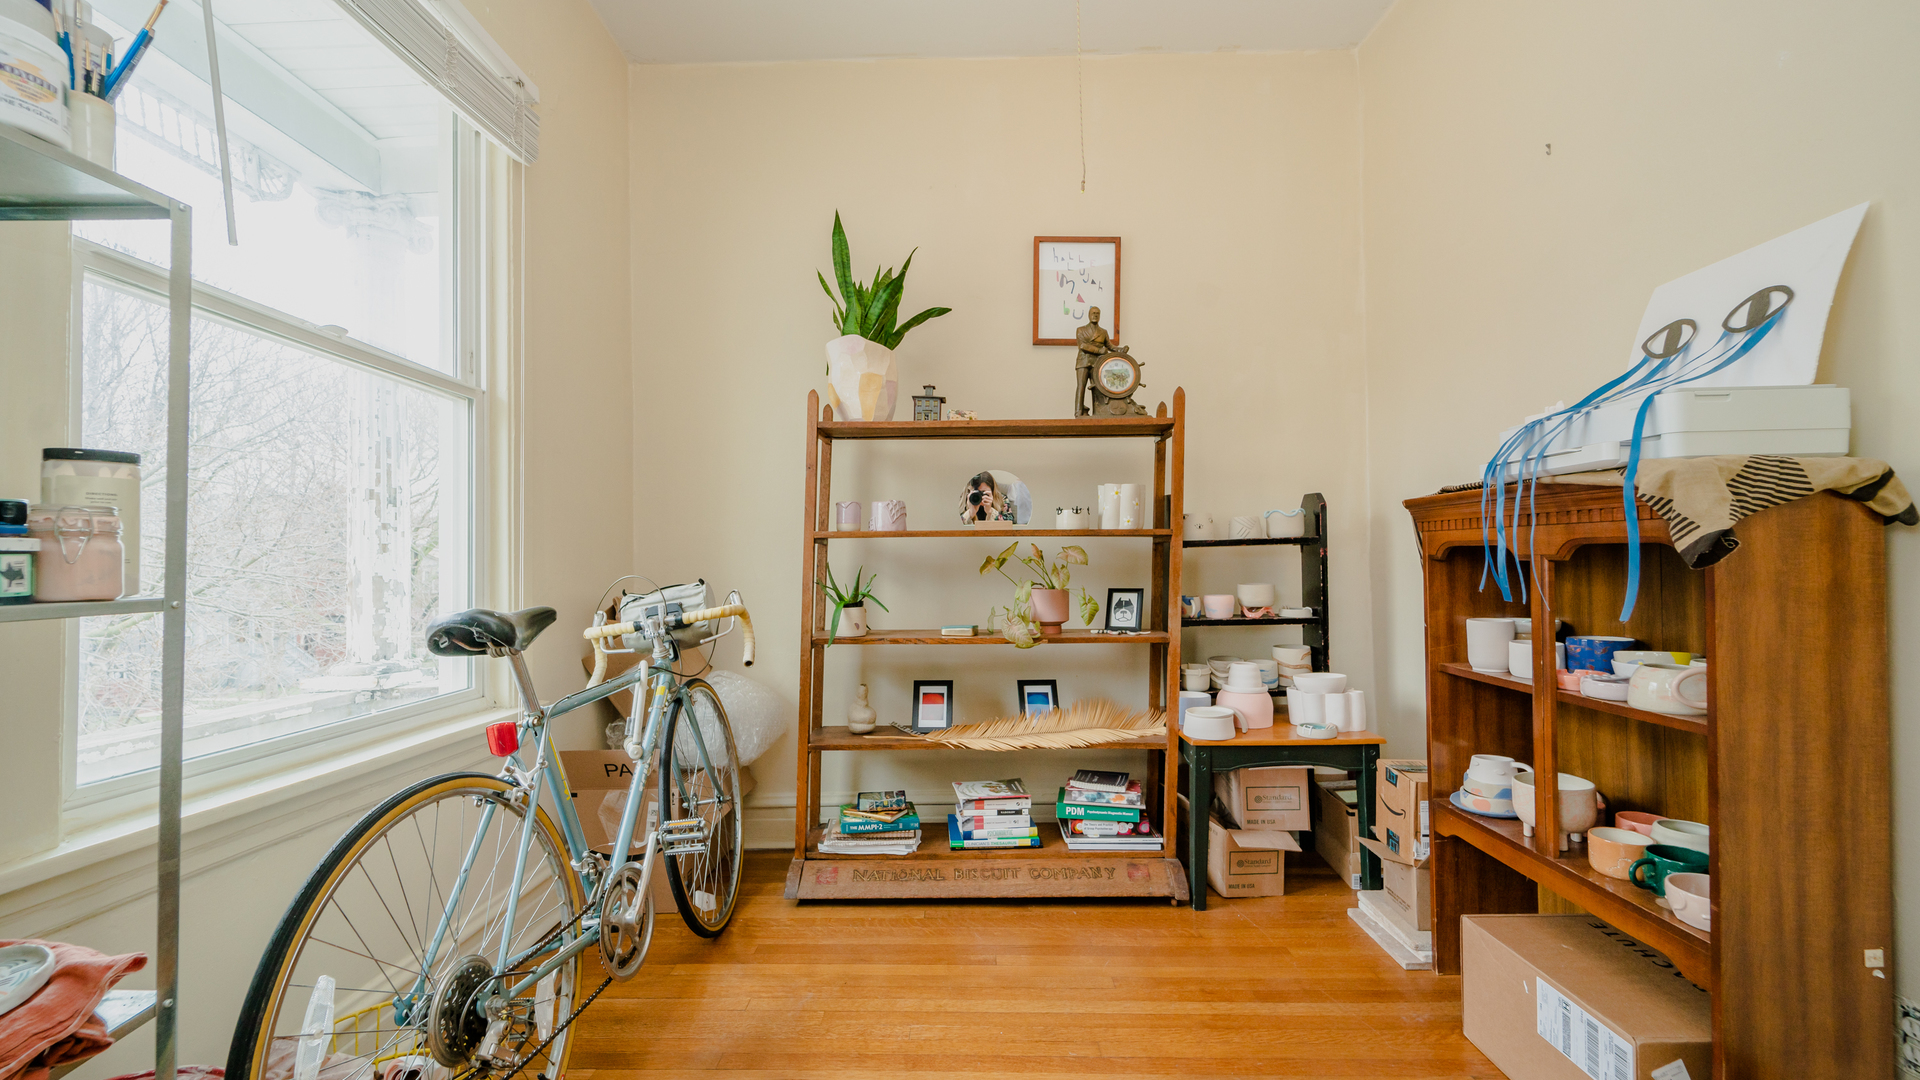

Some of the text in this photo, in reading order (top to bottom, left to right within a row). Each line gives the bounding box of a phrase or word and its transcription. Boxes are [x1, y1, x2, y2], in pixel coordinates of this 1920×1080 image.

[1066, 806, 1084, 816] PDM
[858, 823, 883, 831] MMPI-2
[852, 867, 1116, 881] NATIONAL BISCUIT COMPANY
